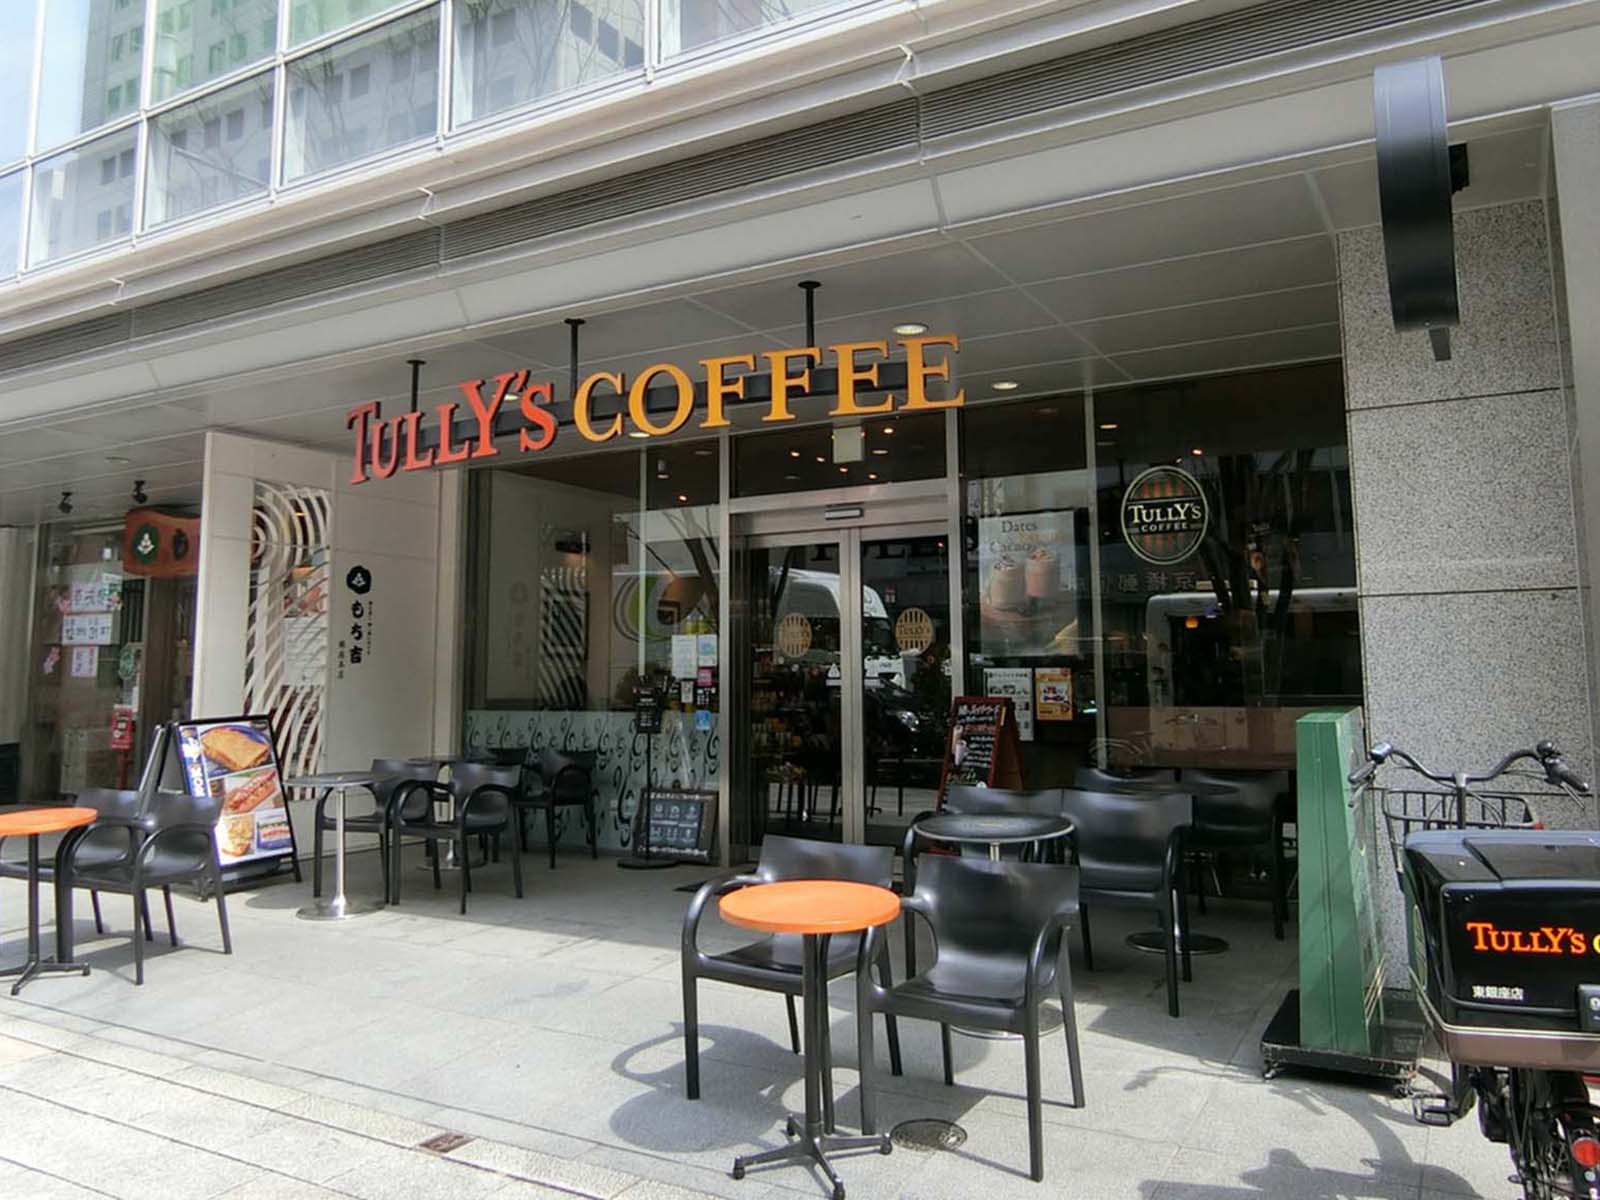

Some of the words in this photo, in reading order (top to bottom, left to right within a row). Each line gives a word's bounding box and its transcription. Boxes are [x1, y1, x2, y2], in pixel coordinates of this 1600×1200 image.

[346, 368, 558, 485] TULLY'S
[573, 334, 966, 443] COFFEE
[1128, 502, 1202, 524] TULLY'S
[1141, 522, 1188, 532] COFFEE
[349, 600, 364, 664] もち吉
[1466, 921, 1587, 954] TULLY'S
[1472, 985, 1524, 1001] 東銀座店
